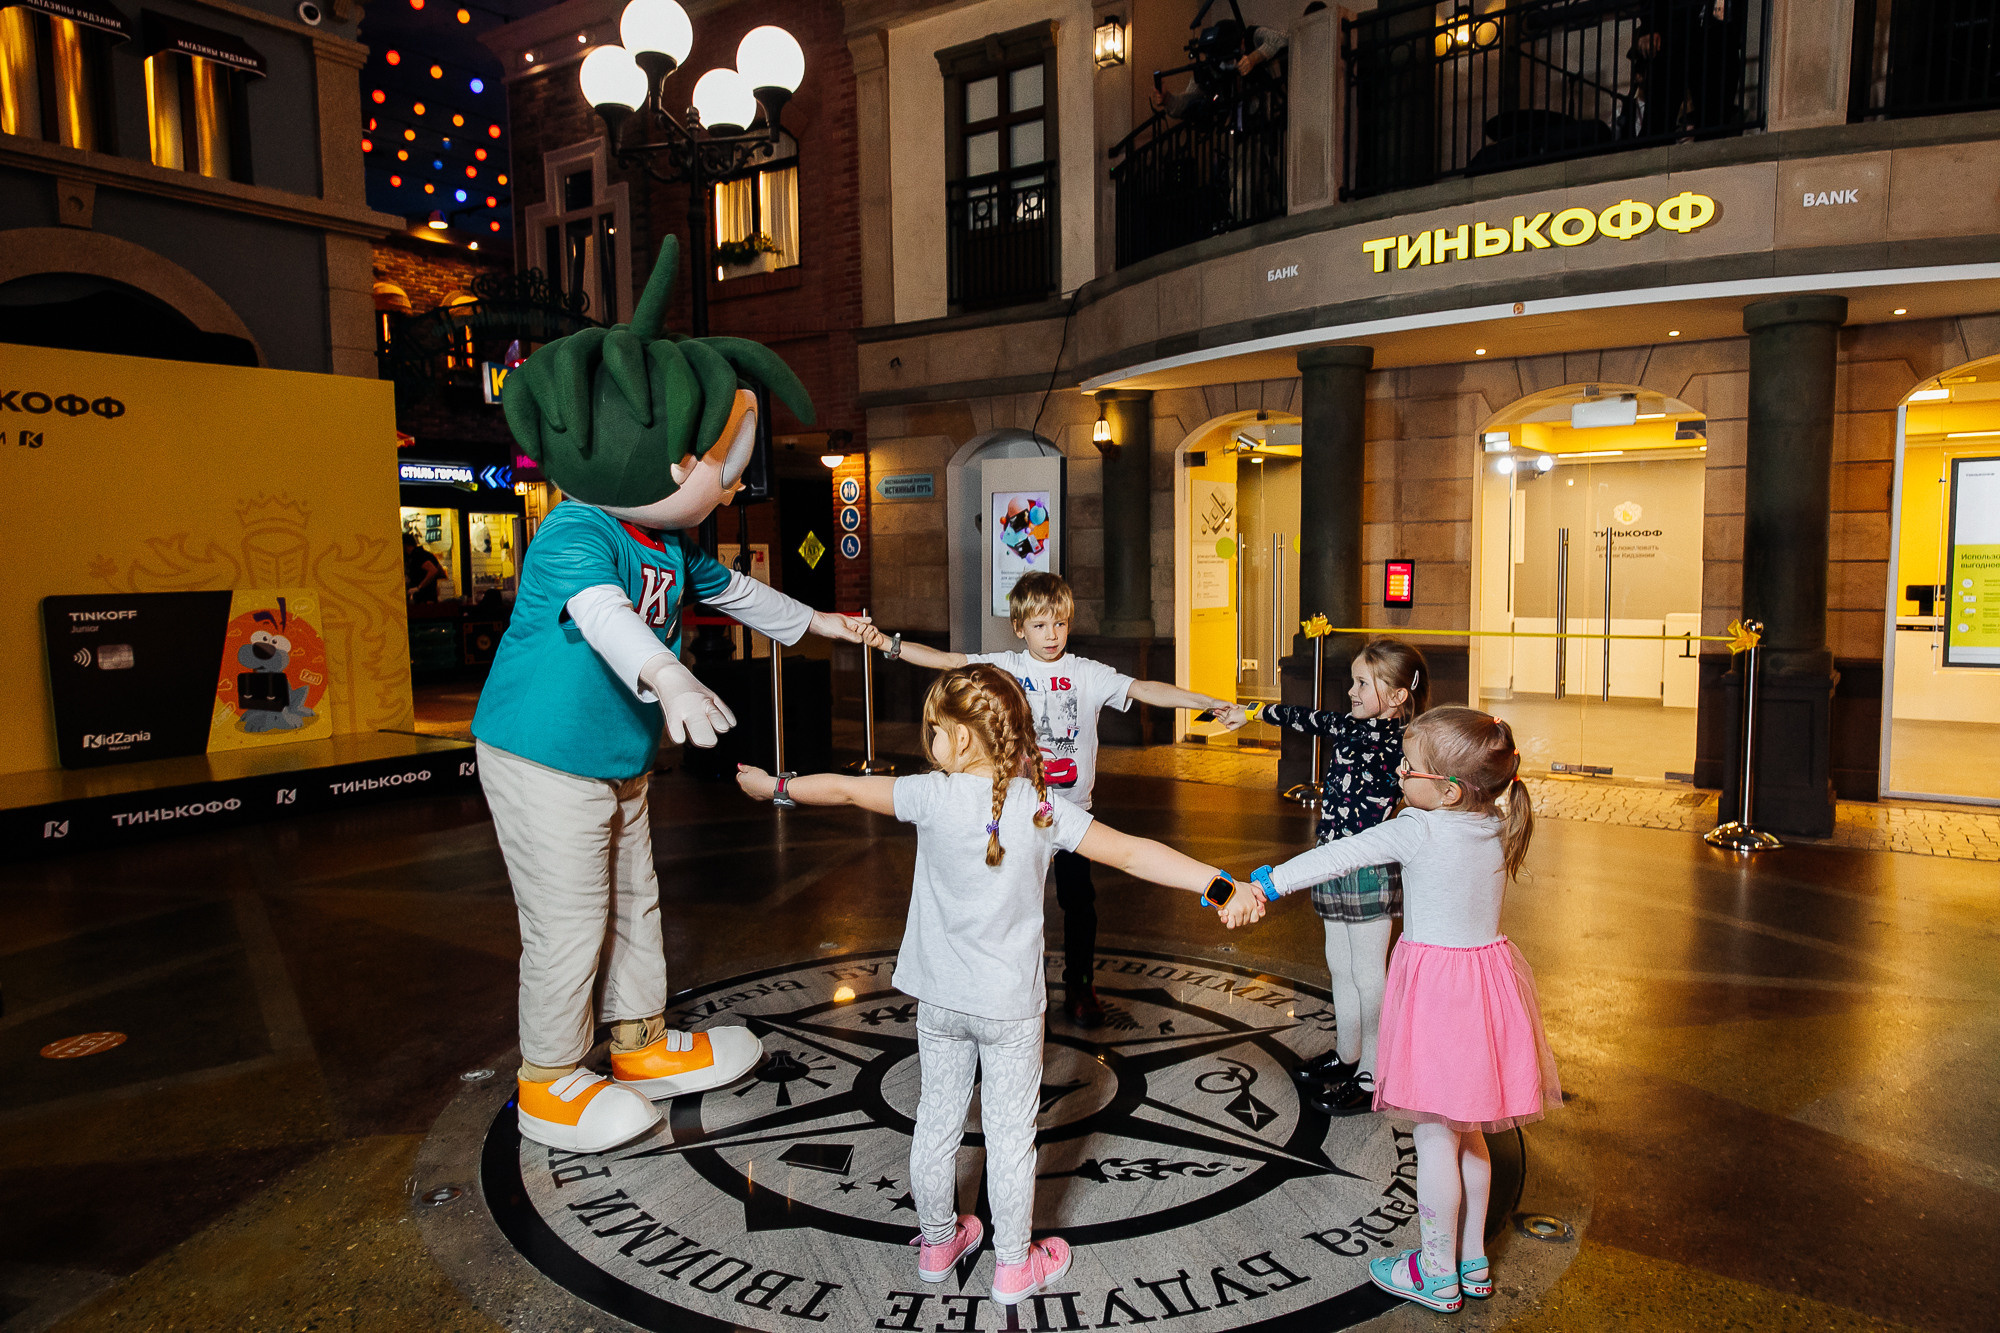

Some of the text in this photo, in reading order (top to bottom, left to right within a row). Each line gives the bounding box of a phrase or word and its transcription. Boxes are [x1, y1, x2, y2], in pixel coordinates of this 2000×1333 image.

[76, 9, 121, 28] КИДЗАНИИ
[177, 39, 218, 56] МАГАЗИНЫ
[1803, 188, 1859, 207] BANK
[1362, 191, 1716, 274] ТИНЬКОФФ
[1267, 264, 1299, 282] БАНК
[0, 390, 126, 419] КОФФ
[401, 465, 473, 482] СТИЛЬ ГОРОДА
[69, 610, 137, 621] TINKOFF
[70, 625, 99, 633] Junior
[83, 730, 151, 749] KidZania
[112, 798, 241, 827] ТИНЬКОФФ
[329, 769, 432, 795] ТИНЬКОФФ
[566, 1188, 844, 1323] ТВОИМИ
